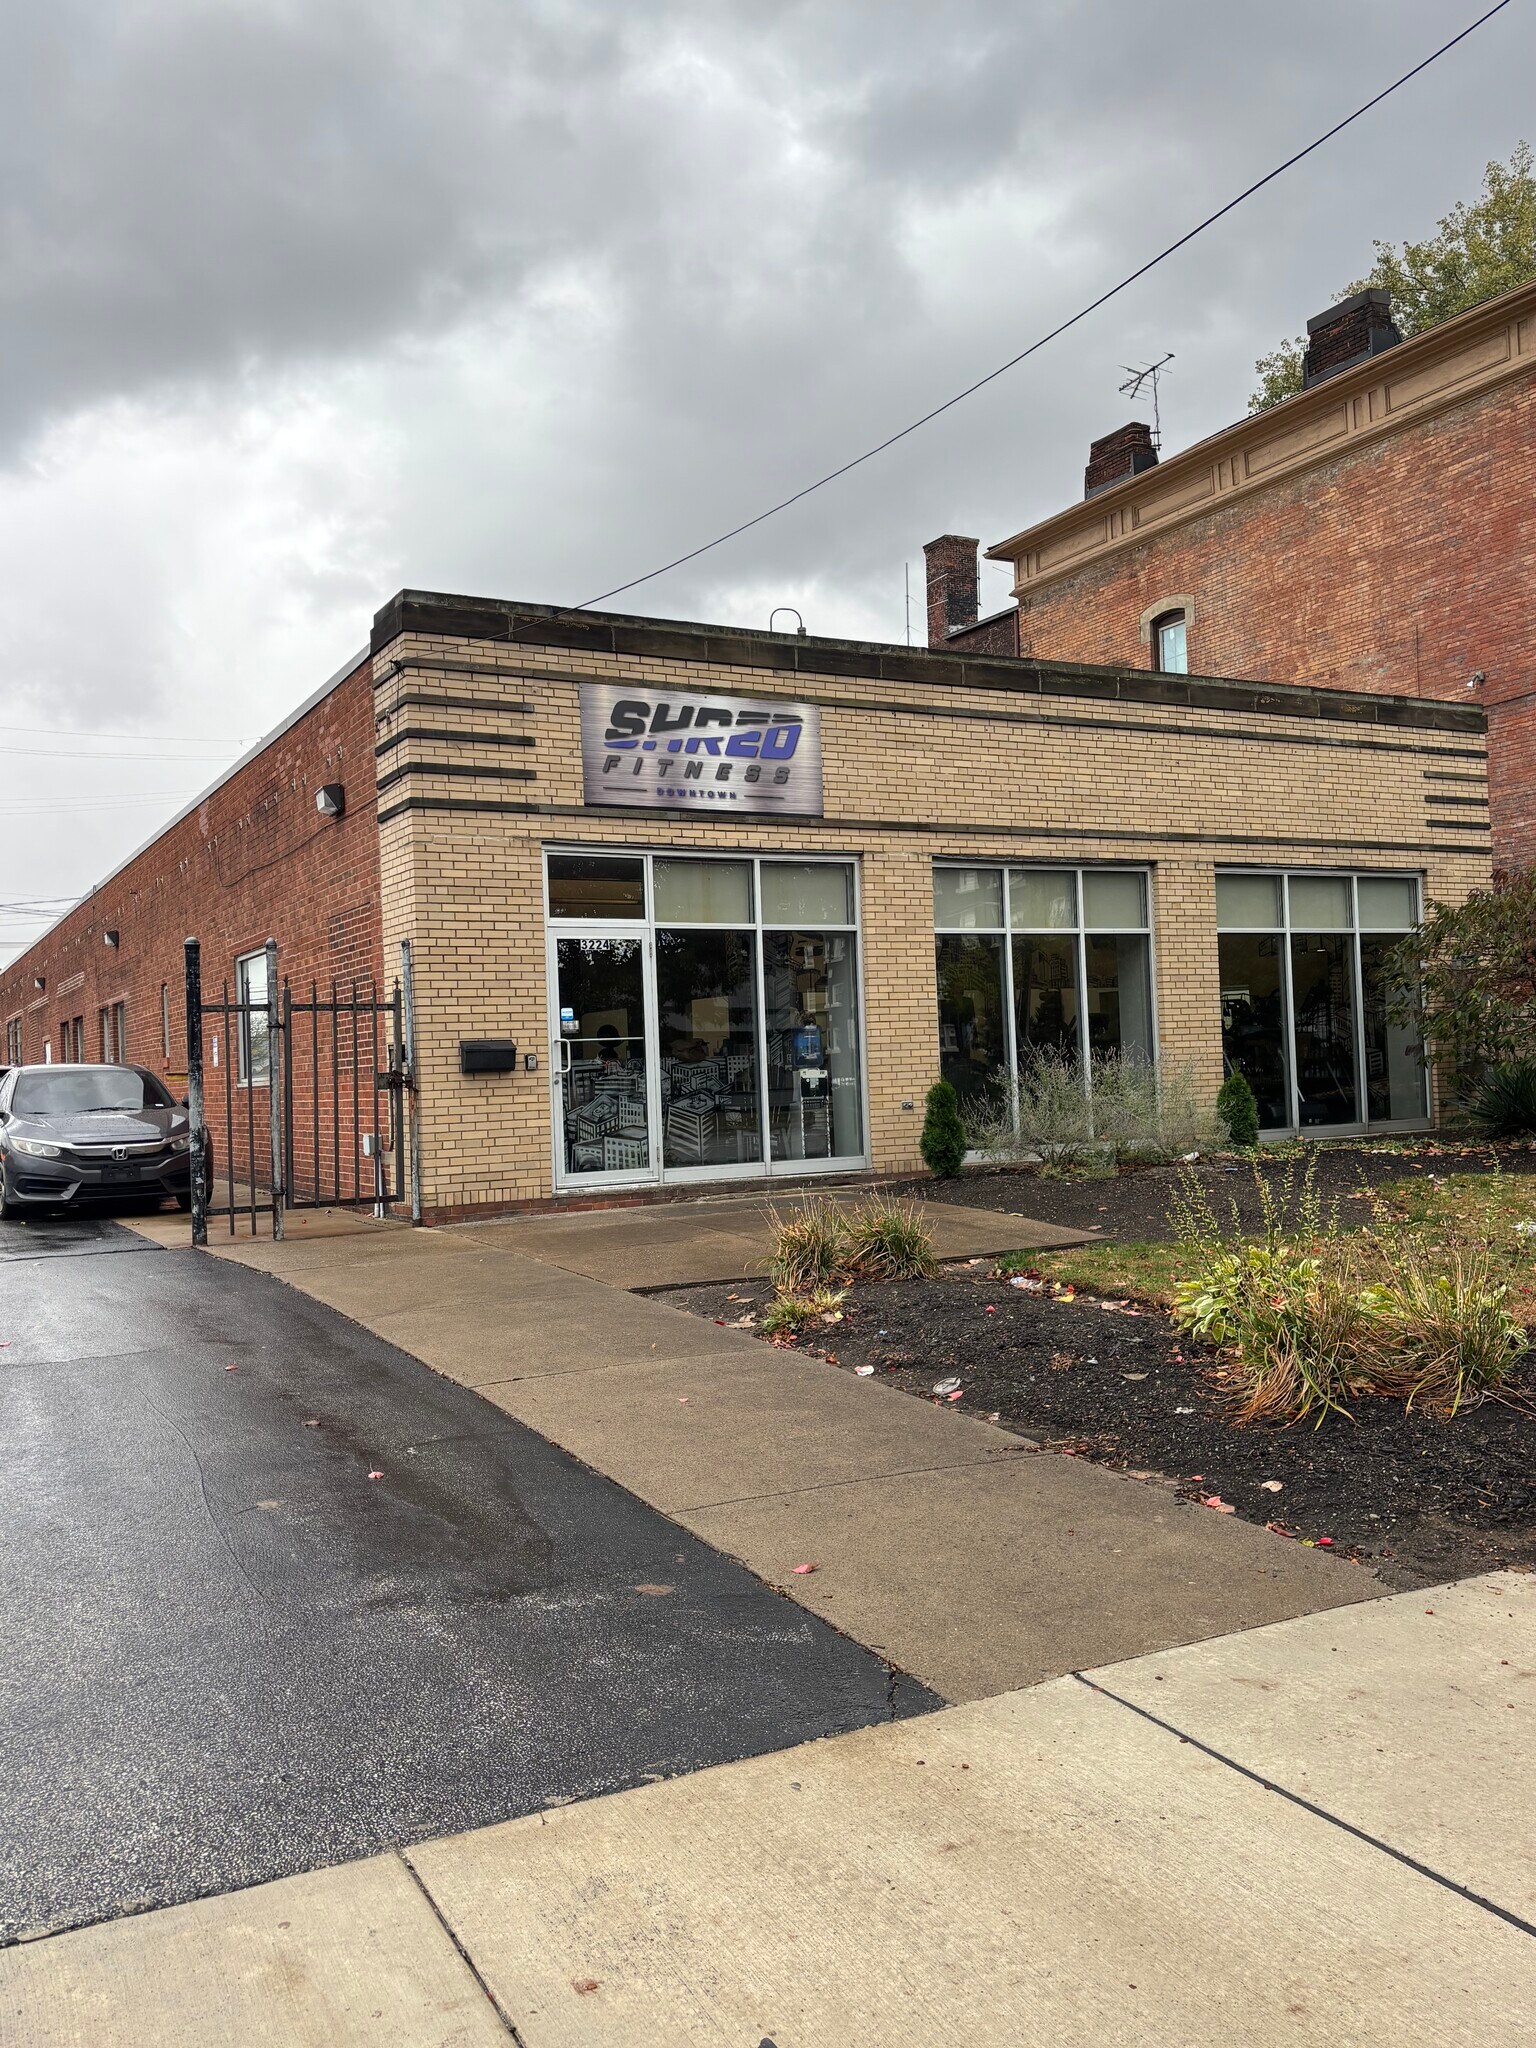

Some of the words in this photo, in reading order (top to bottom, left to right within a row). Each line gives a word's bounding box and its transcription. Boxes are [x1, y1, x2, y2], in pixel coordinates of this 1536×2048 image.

[603, 699, 804, 761] SHRED
[602, 754, 790, 785] FITNESS
[656, 787, 738, 800] DOWNTOWN
[581, 939, 610, 950] 3224
